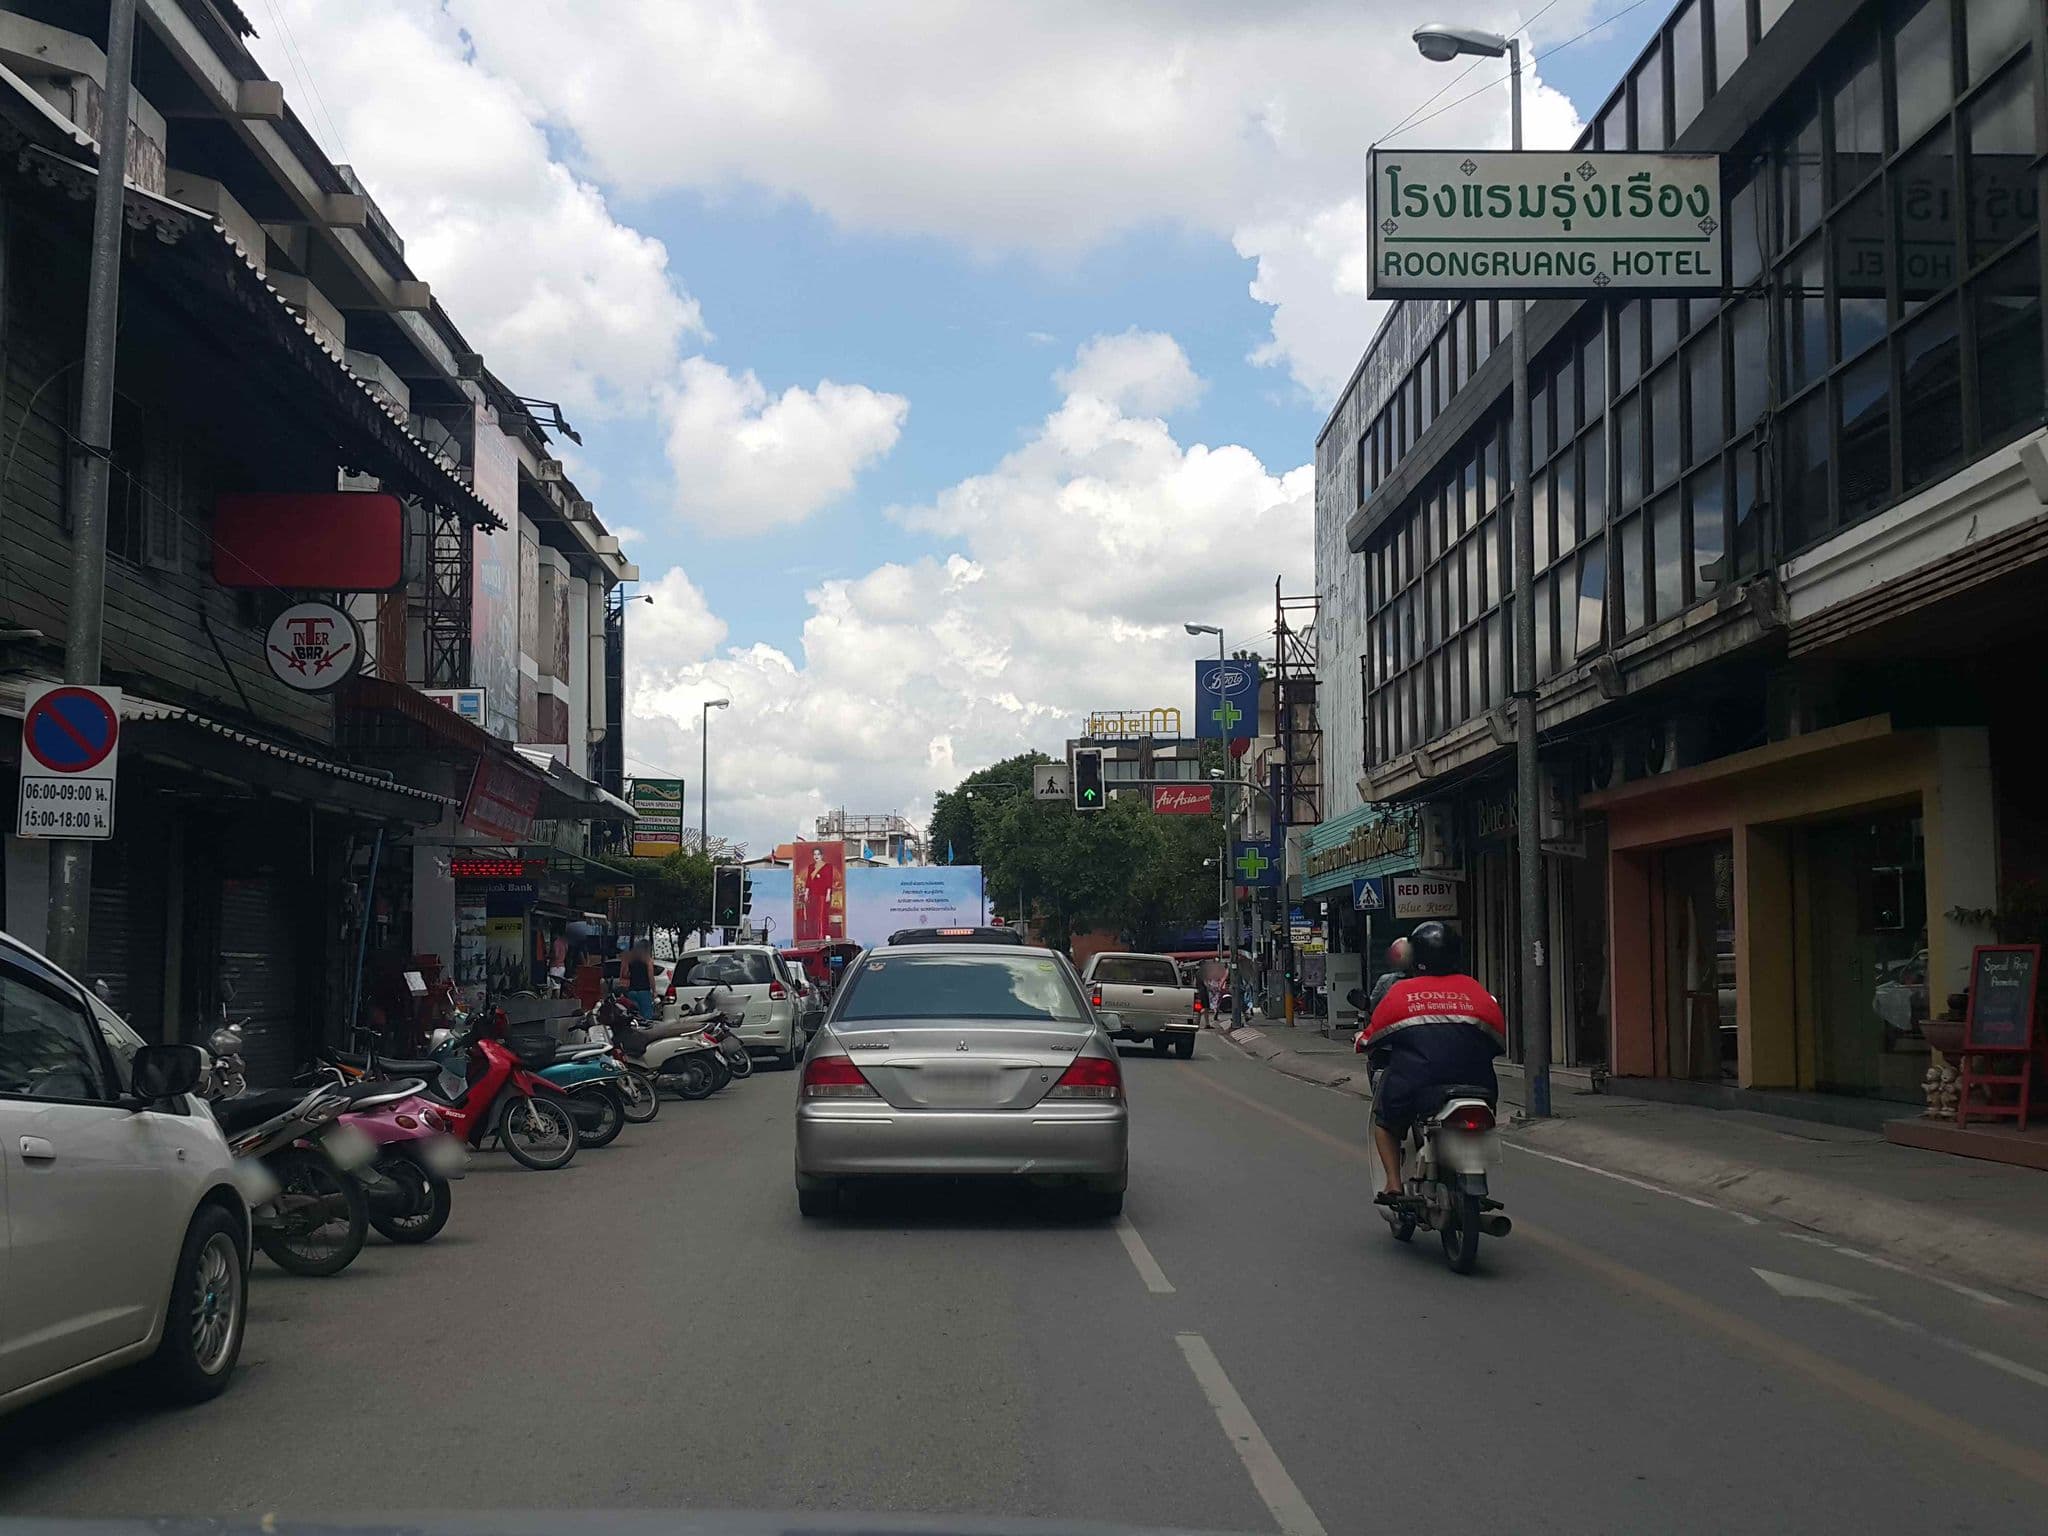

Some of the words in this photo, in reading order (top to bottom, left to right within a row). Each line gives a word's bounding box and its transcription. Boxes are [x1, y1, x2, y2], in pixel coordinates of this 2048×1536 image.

[1385, 165, 1711, 231] โรงแรมรุ่งเรือง
[1384, 251, 1597, 277] ROONGRUANG
[1612, 250, 1712, 276] HOTEL
[294, 646, 324, 660] BAR
[1090, 713, 1146, 733] Hotel
[26, 783, 92, 801] 06:00-09:00
[24, 810, 91, 828] 15:00-18:00
[507, 883, 533, 892] Bank
[1398, 885, 1420, 896] RED
[1422, 884, 1452, 895] RUBY
[1398, 902, 1422, 912] Blue
[1407, 991, 1471, 1002] HONDA
